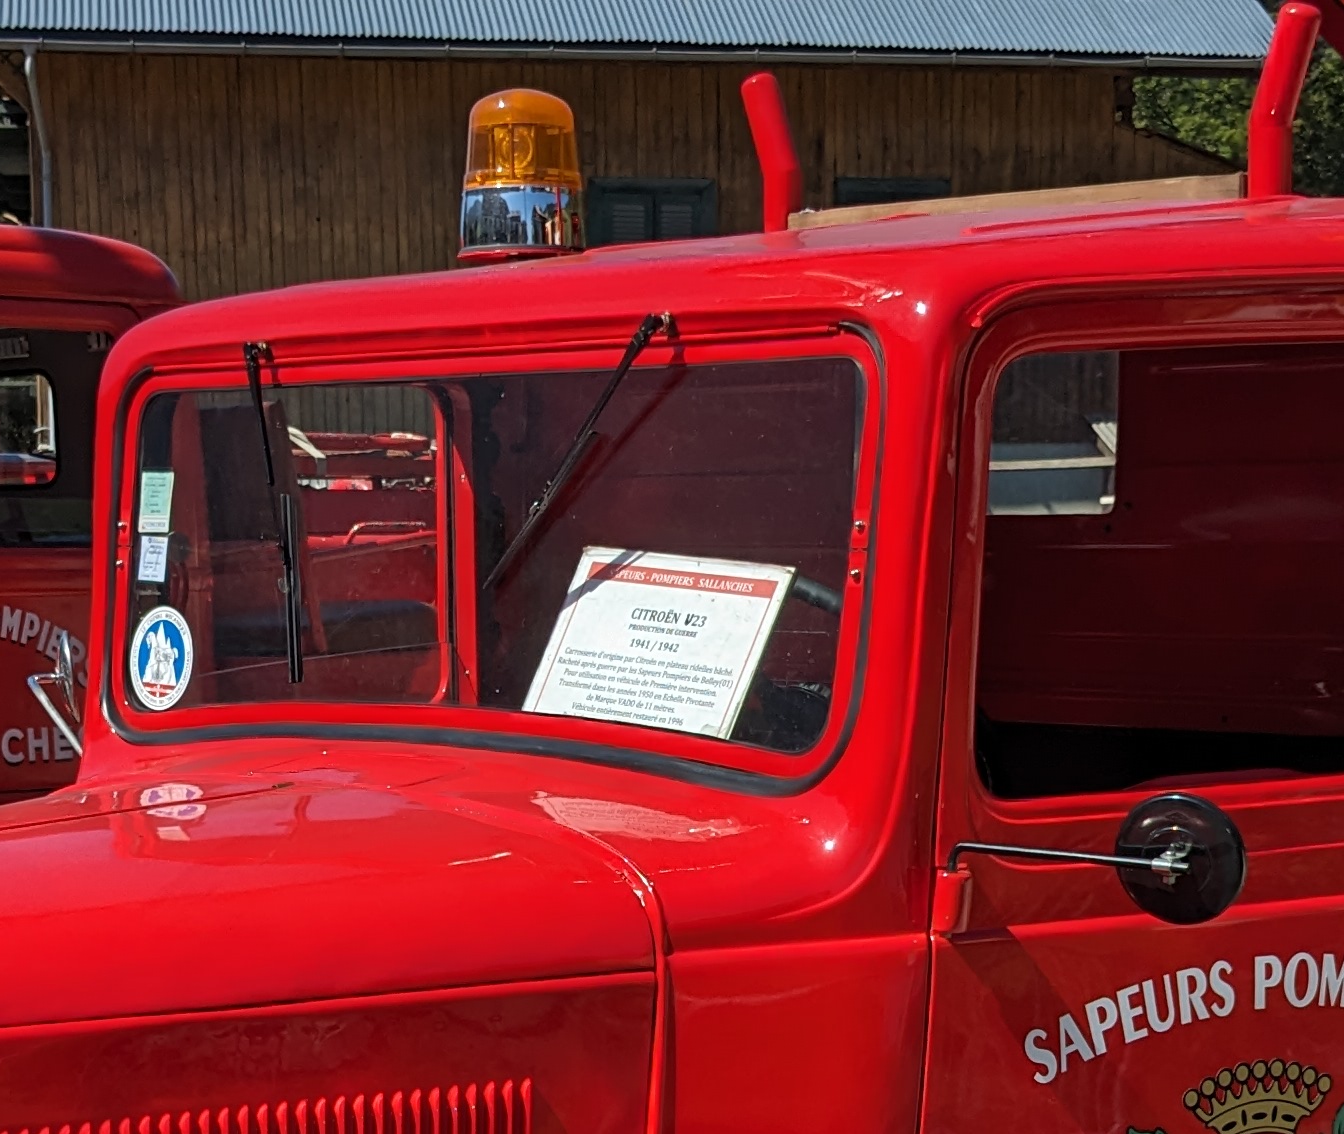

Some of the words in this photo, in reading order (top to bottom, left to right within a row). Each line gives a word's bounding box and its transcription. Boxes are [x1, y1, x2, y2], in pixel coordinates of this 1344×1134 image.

[650, 573, 694, 586] POMPIERS
[698, 578, 753, 592] SALLANCHES
[631, 608, 680, 623] CITROËN
[628, 623, 665, 633] PRODUCTION
[674, 629, 697, 637] GUERRE
[630, 638, 650, 649] 1941
[657, 641, 679, 652] 1942
[557, 656, 580, 666] Racheté
[596, 663, 617, 671] guerre
[628, 666, 637, 674] les
[637, 667, 661, 677] Sapeurs
[661, 670, 691, 681] Pompiers
[691, 674, 700, 683] de
[564, 646, 597, 657] Carrosserie
[597, 651, 623, 661] d'origine
[665, 660, 688, 670] plateau
[563, 667, 578, 676] Pour
[578, 670, 607, 680] utilisation
[616, 676, 640, 685] véhicule
[649, 679, 677, 690] Première
[558, 677, 591, 689] Transformé
[591, 683, 606, 691] dans
[606, 685, 615, 693] les
[616, 688, 637, 696] années
[638, 689, 653, 698] 1950
[685, 696, 714, 707] Pivotante
[585, 693, 594, 701] de
[594, 694, 617, 705] Marque
[635, 700, 644, 708] de
[644, 701, 652, 710] 11
[571, 701, 596, 712] Véhicule
[596, 707, 632, 718] entièrement
[632, 713, 658, 722] restauré
[667, 716, 683, 726] 1996
[1024, 960, 1235, 1084] SAPEURS
